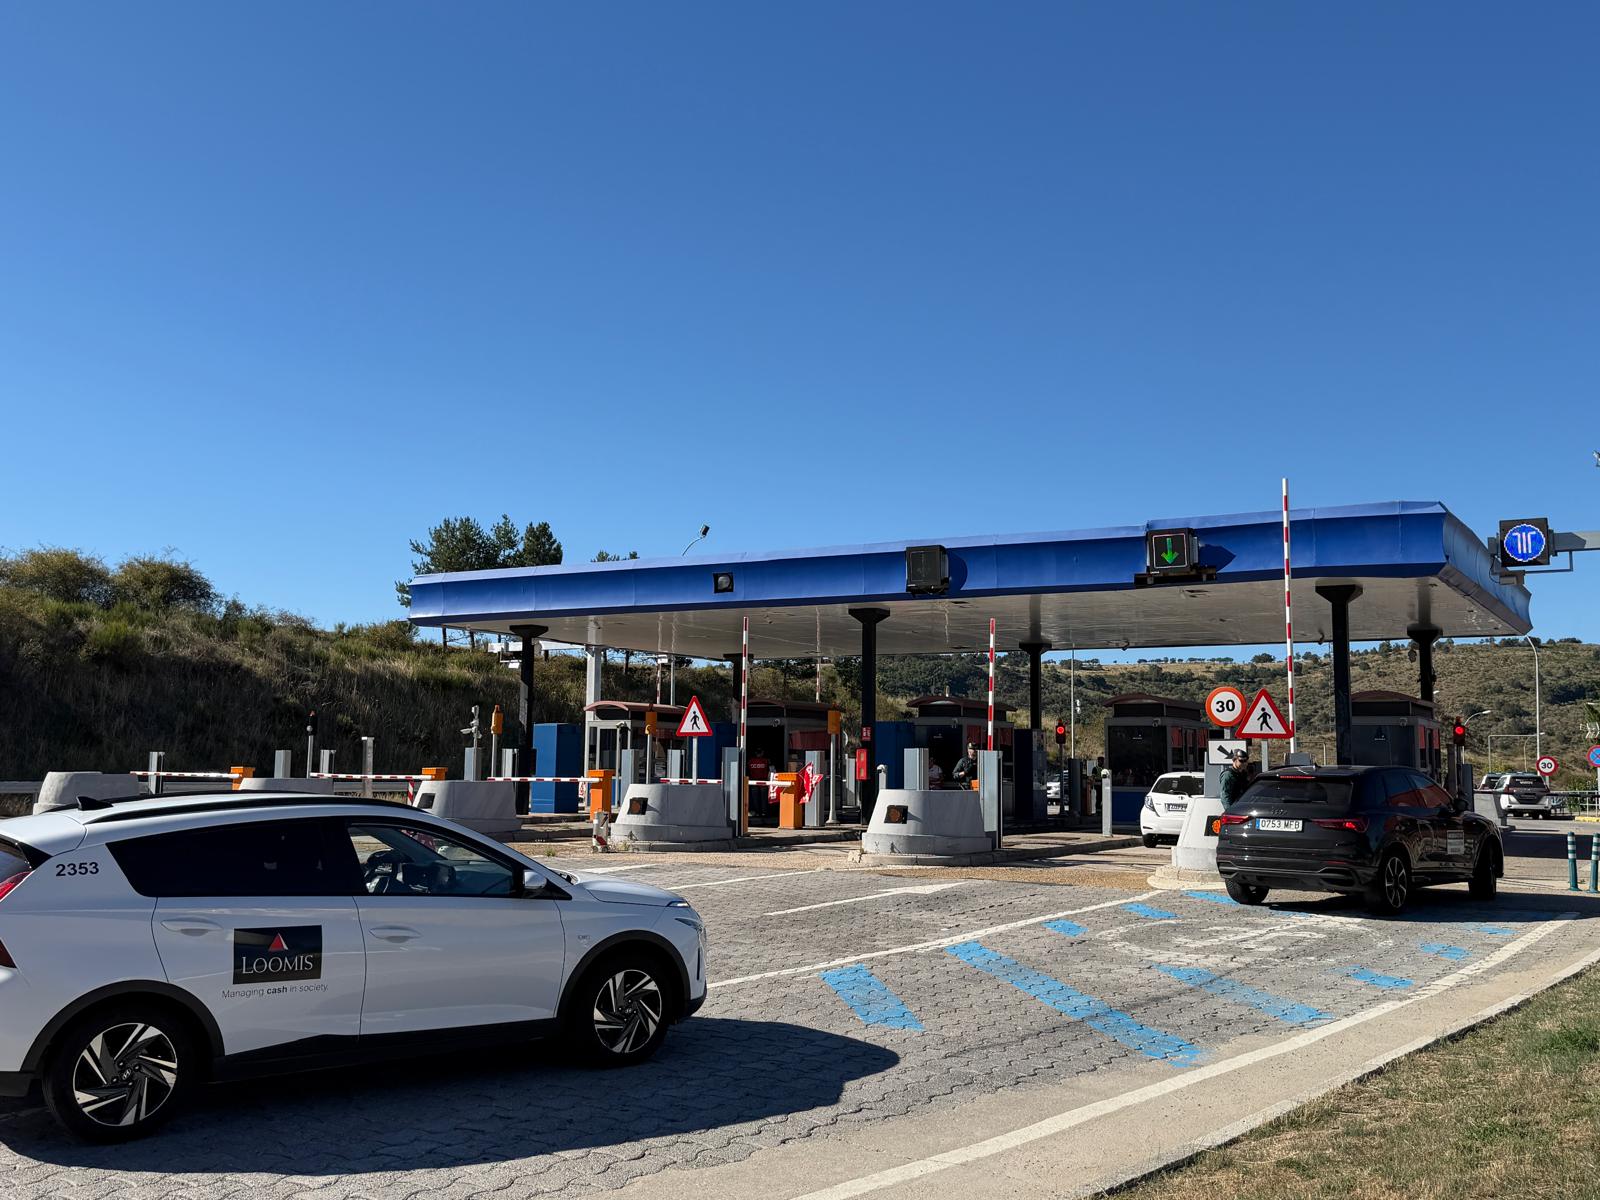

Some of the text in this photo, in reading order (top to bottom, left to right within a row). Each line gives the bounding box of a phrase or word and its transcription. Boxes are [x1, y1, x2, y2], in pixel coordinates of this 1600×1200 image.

[1215, 699, 1236, 713] 30
[1260, 819, 1300, 830] 0753 MFB
[55, 861, 100, 877] 2353
[241, 954, 314, 974] LOOMIS
[222, 988, 265, 999] Managing
[266, 984, 288, 995] cash
[289, 985, 298, 993] in
